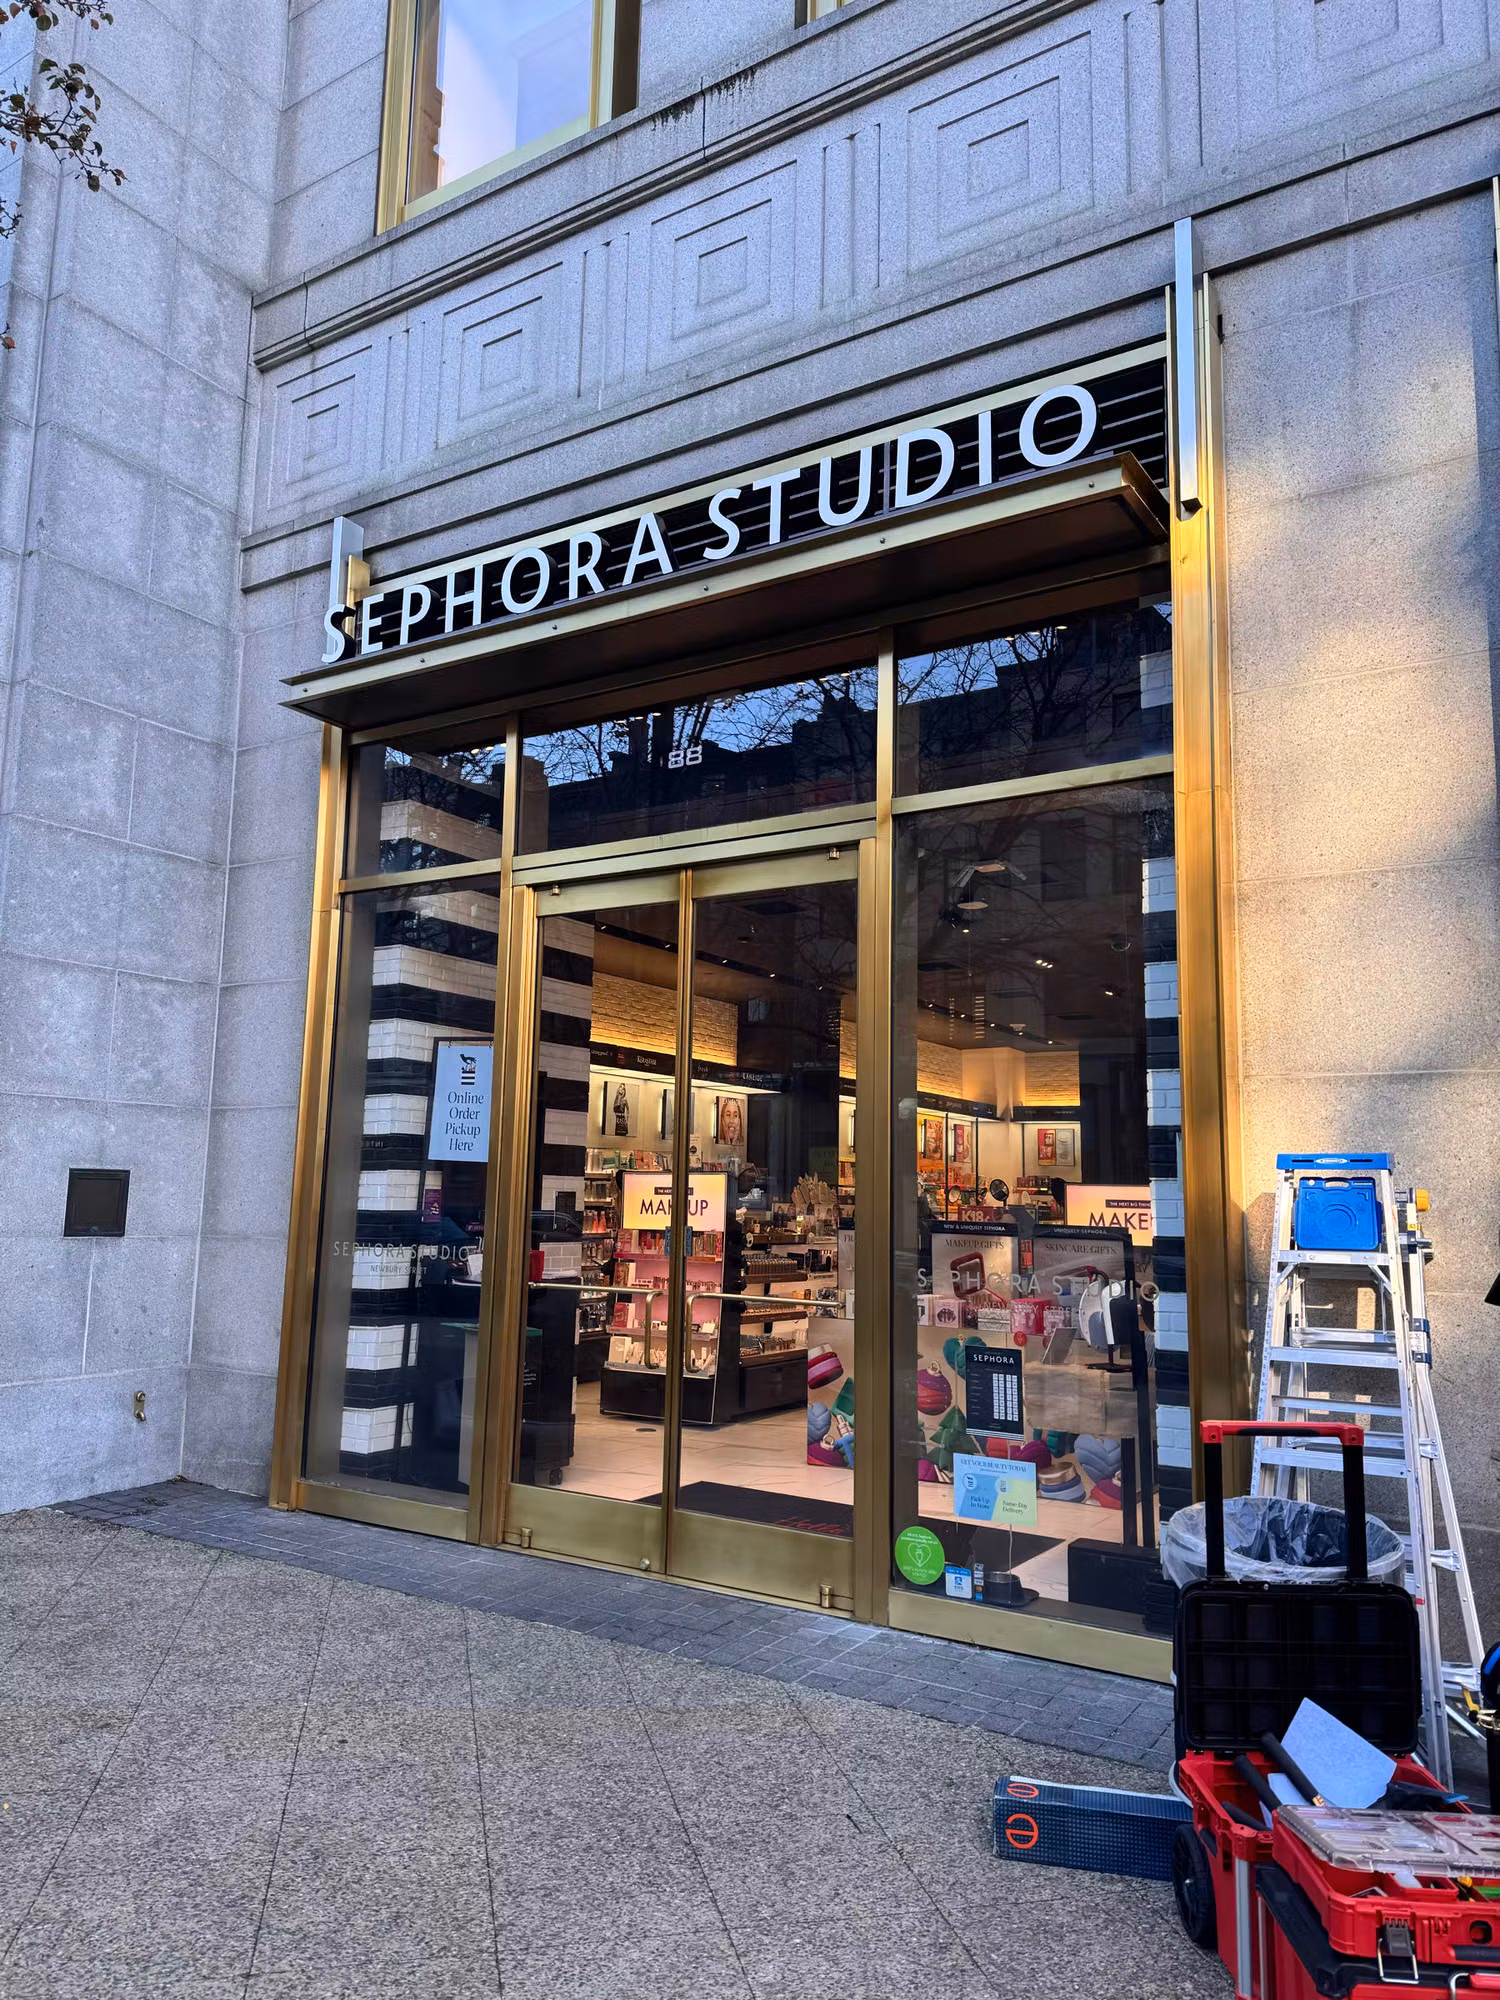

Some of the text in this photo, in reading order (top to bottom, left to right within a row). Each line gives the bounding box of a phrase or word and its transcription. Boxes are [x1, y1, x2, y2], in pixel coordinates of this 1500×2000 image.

[321, 384, 1097, 665] SEPHORA STUDIO
[668, 746, 702, 769] 88
[447, 1091, 485, 1105] Online
[449, 1106, 481, 1120] Order
[445, 1122, 481, 1139] Pickup
[449, 1138, 474, 1152] Here
[640, 1198, 709, 1217] MAUP
[1088, 1212, 1153, 1231] MAKE
[333, 1241, 469, 1261] SEPHORA STUDIO
[945, 1239, 1005, 1250] MAKEUP GIFTS
[1045, 1242, 1117, 1255] SKINCARE GIFTS
[370, 1265, 402, 1274] NEWBURY
[918, 1268, 1041, 1294] SPHORA
[973, 1353, 1015, 1364] SEPHORA
